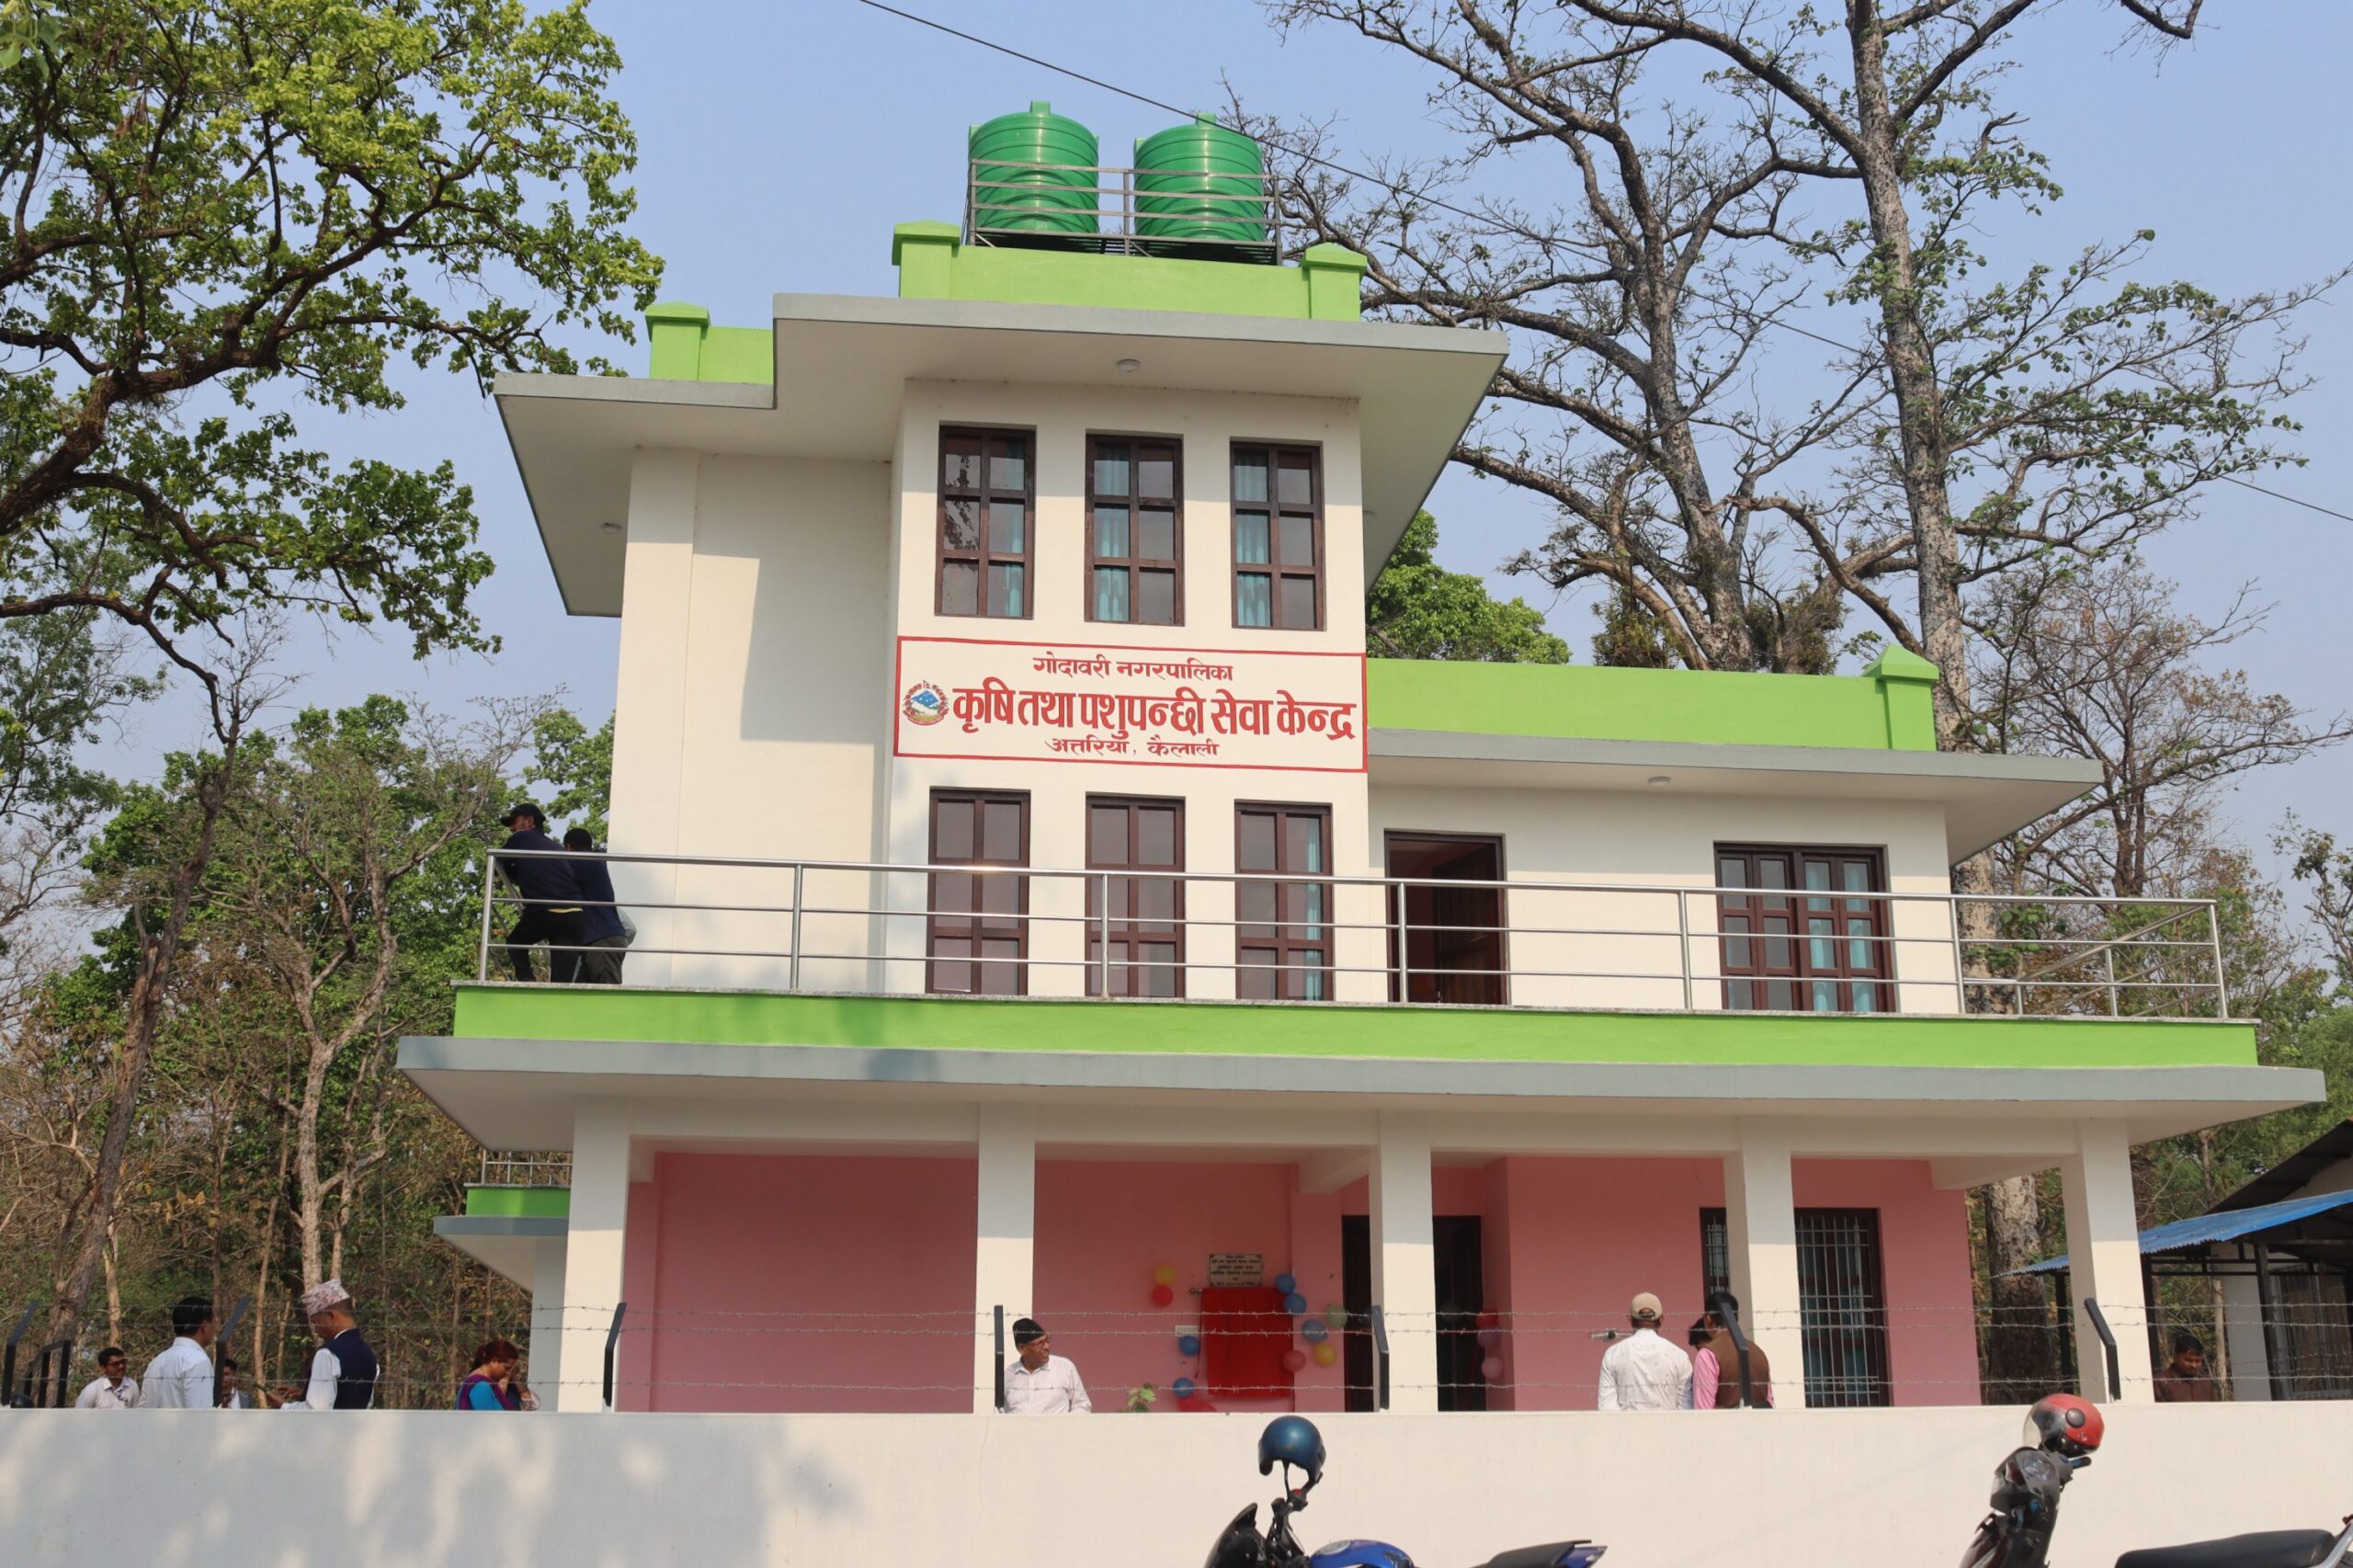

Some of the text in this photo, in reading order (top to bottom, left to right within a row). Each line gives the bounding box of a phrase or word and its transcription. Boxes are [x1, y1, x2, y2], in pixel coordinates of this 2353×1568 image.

[1032, 651, 1233, 681] गोदावरी नगरपालिका
[952, 676, 1357, 741] कृषि तथा पशुपन्छी सेवा केन्द्र
[1147, 734, 1220, 758] कैलाली
